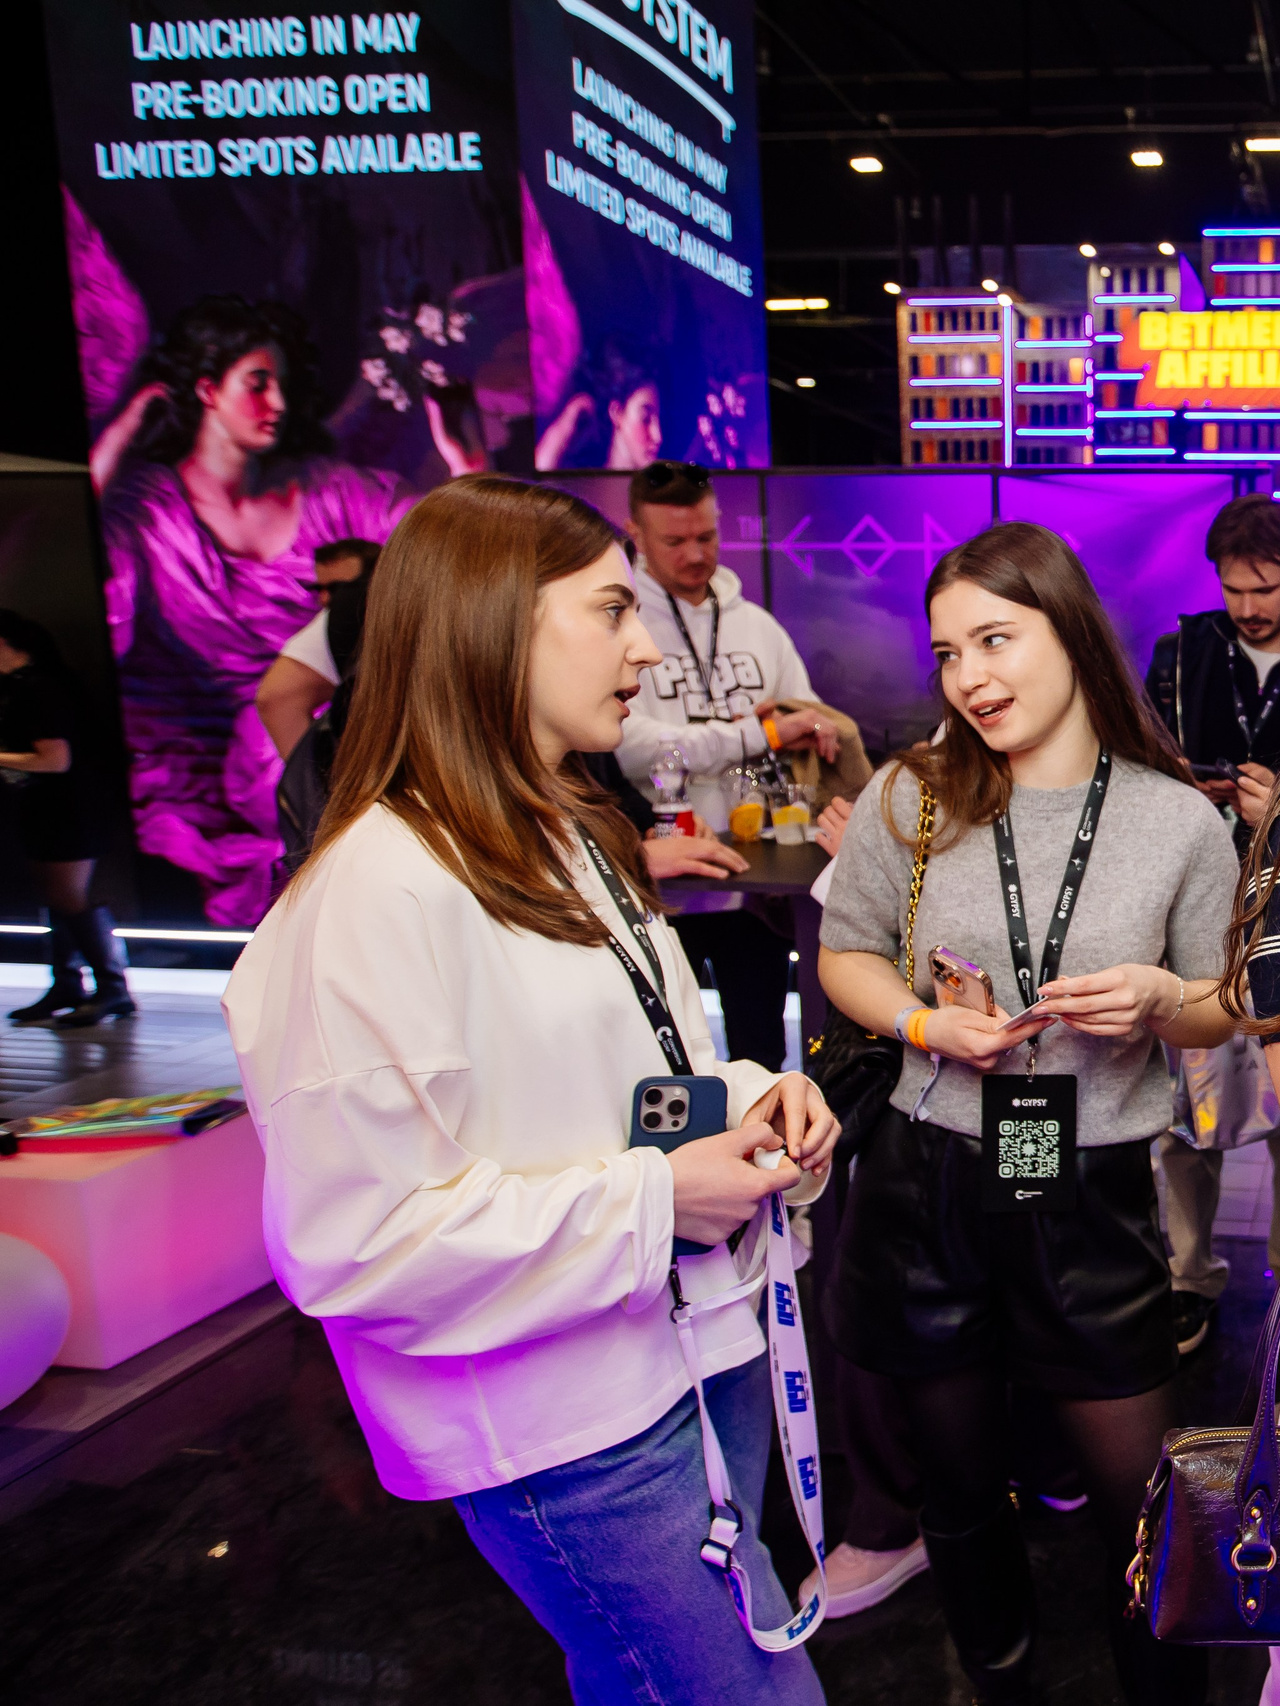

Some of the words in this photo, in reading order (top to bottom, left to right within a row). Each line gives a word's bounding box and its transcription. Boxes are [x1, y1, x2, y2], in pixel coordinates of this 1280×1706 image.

[130, 16, 307, 61] LAUNCHING
[311, 14, 347, 55] IN
[351, 12, 421, 55] MAY
[621, 0, 734, 95] STEM
[131, 75, 341, 119] PRE-BOOKING
[343, 72, 431, 115] OPEN
[572, 56, 675, 158] LAUNCHING
[674, 131, 695, 173] IN
[694, 146, 728, 194] MAY
[95, 138, 216, 179] LIMITED
[217, 135, 318, 177] SPOTS
[320, 131, 483, 174] AVAILABLE
[572, 111, 692, 216] PRE-BOOKING
[690, 190, 732, 242] OPEN
[545, 149, 626, 225] LIMITED
[625, 197, 681, 256] SPOTS
[679, 229, 753, 297] AVAILABLE
[592, 848, 613, 876] GYPSY
[1009, 893, 1021, 918] GYPSY
[1060, 885, 1075, 911] GYPSY
[615, 944, 637, 973] GYPSY
[1021, 1098, 1047, 1107] GYPSY
